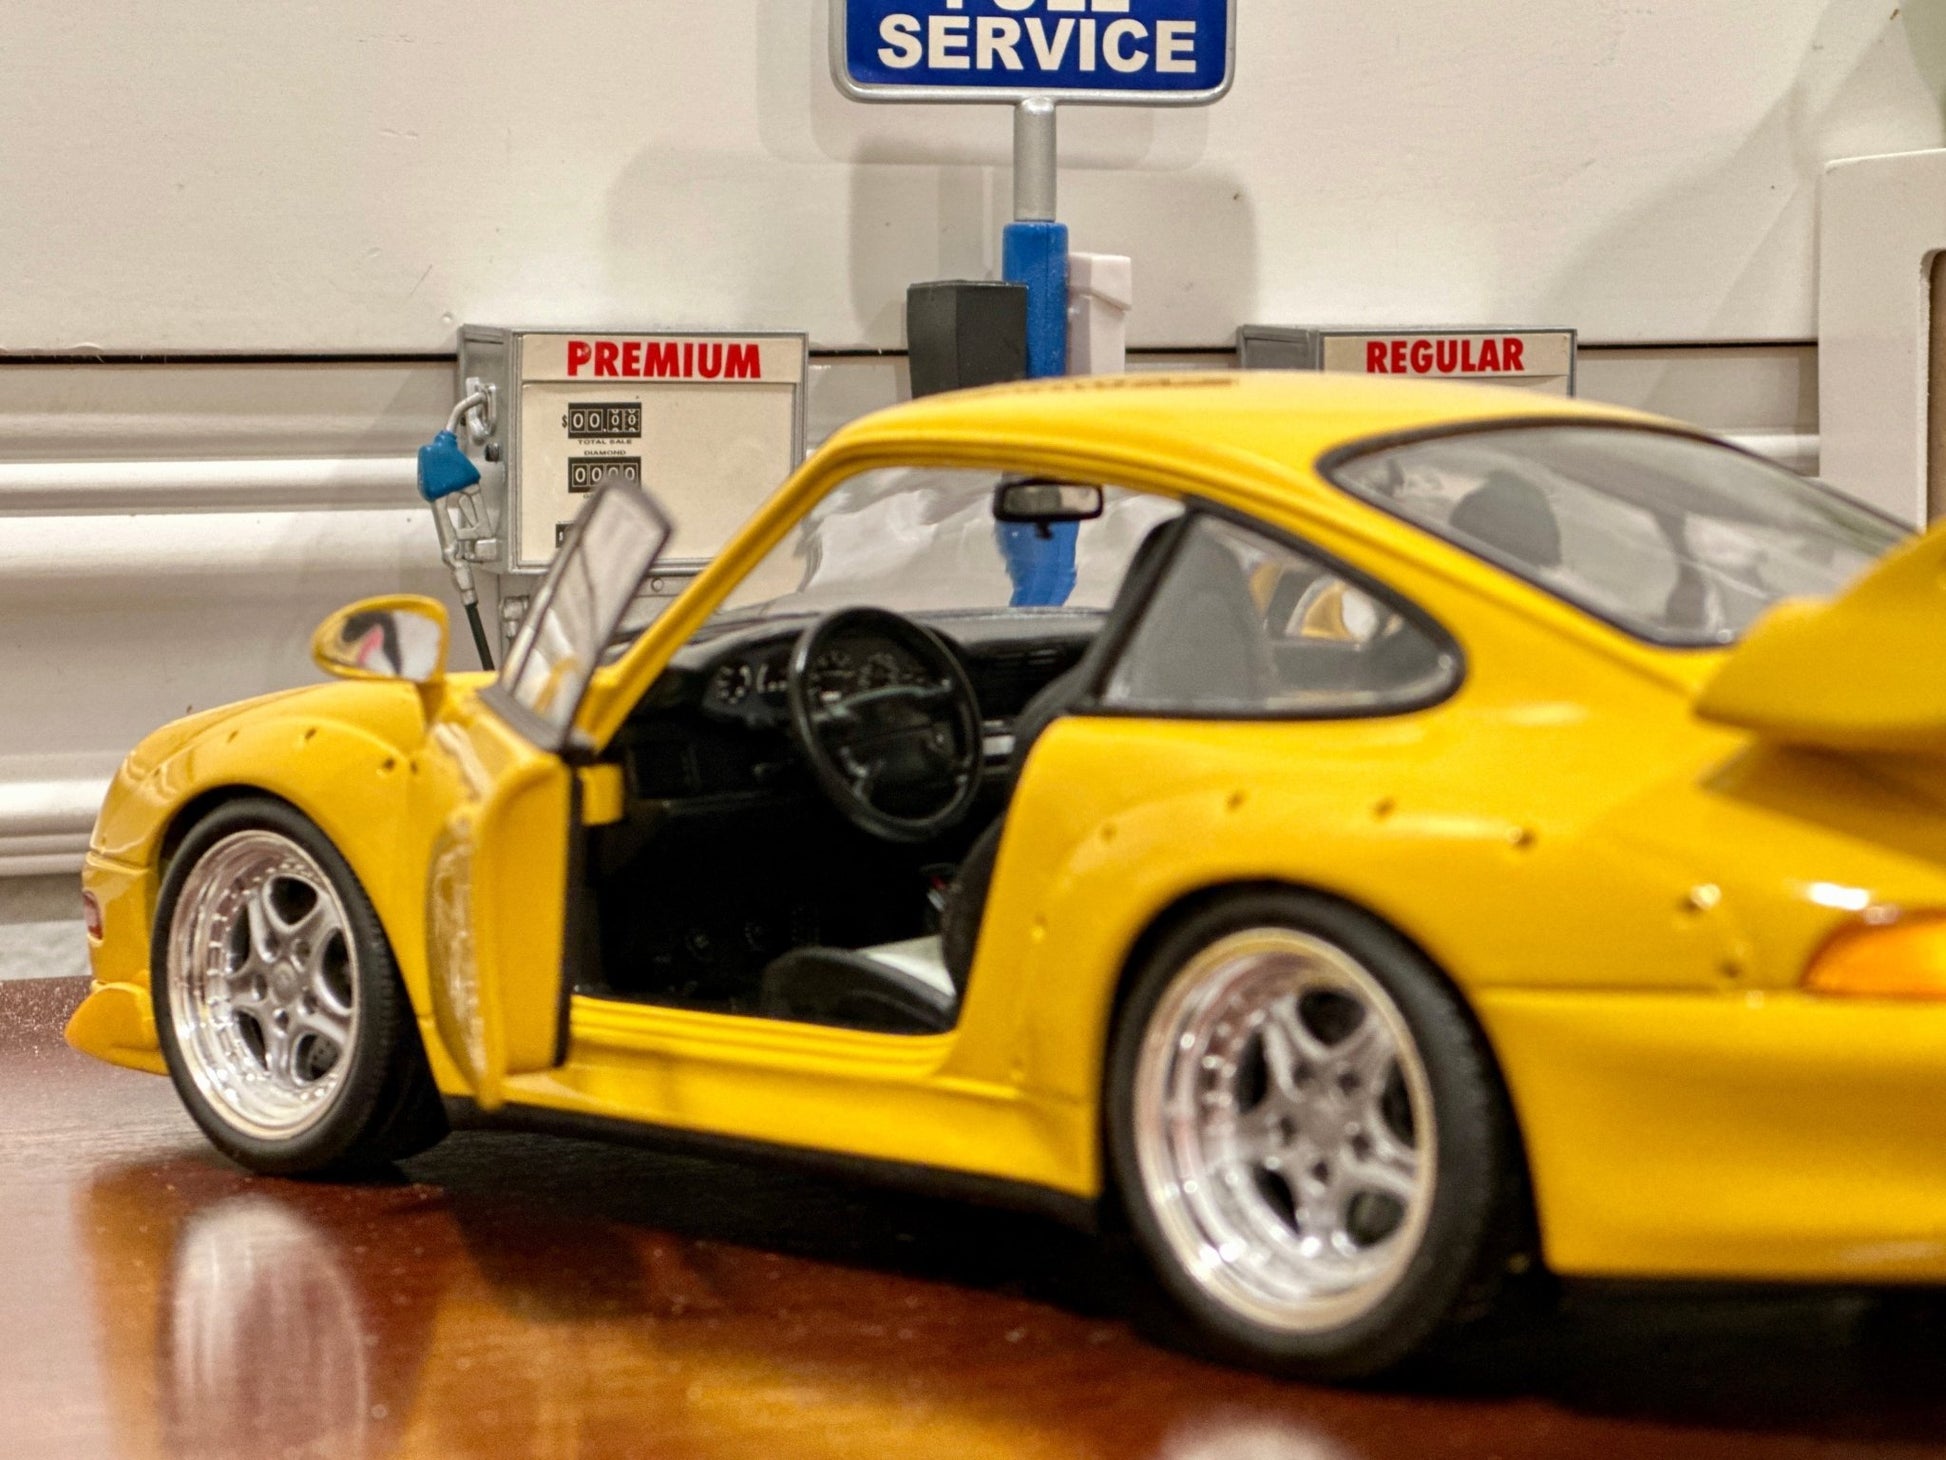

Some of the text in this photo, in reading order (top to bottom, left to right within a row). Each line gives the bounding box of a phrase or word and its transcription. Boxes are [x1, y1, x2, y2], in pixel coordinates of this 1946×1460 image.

[878, 13, 1197, 73] SERVICE
[567, 341, 761, 379] PREMIUM
[1366, 337, 1525, 374] REGULAR
